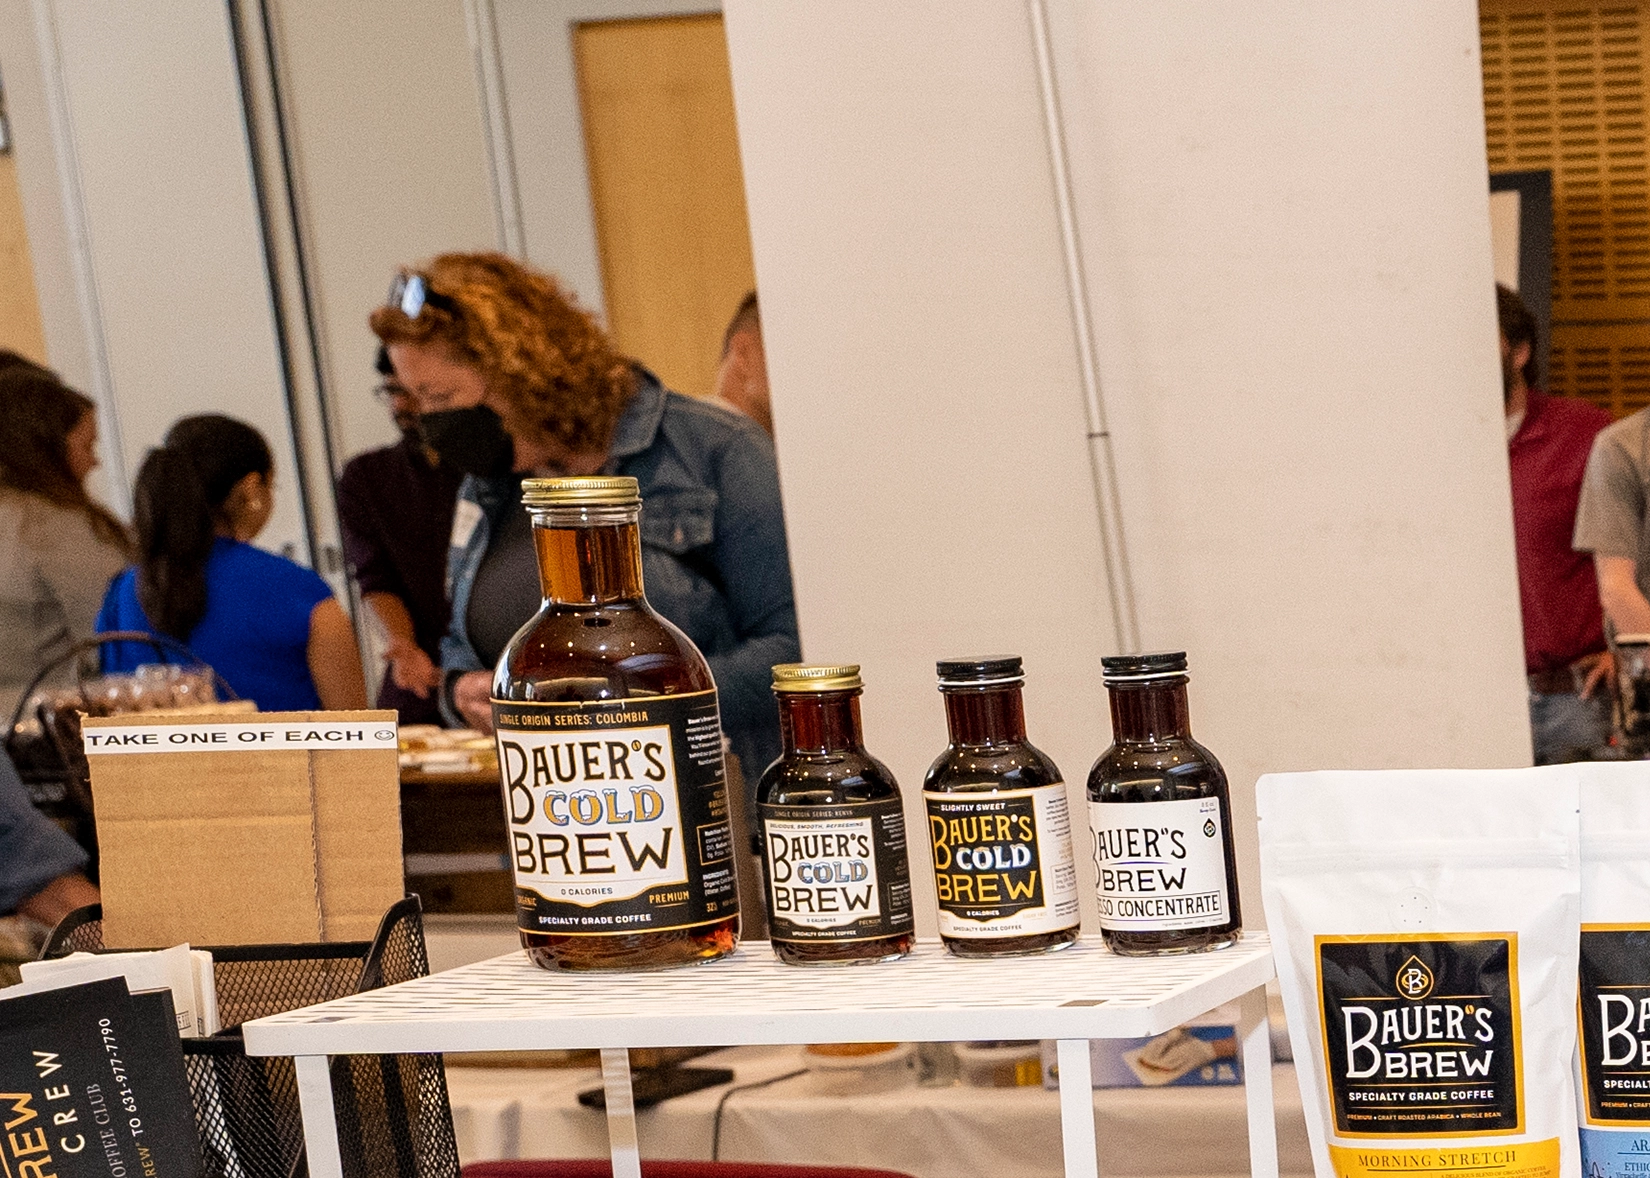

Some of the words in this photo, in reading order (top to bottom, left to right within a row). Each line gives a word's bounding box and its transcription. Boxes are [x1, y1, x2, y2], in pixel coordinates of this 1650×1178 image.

[500, 714, 520, 725] SINGLE
[522, 715, 551, 726] ORIGIN
[555, 714, 593, 726] SERIES:
[596, 711, 648, 724] COLOMBIA
[87, 733, 159, 747] TAKE
[168, 732, 228, 744] ONE
[238, 731, 275, 743] OF
[285, 730, 364, 742] EACH
[501, 740, 666, 825] BAUER'S
[543, 785, 665, 826] COLD
[940, 804, 974, 812] SLIGHTLY
[975, 802, 1006, 810] SWEET
[512, 827, 674, 875] BREW
[929, 814, 1033, 869] BAUER'S
[769, 833, 870, 883] BAUER'S
[956, 843, 1032, 870] COLD
[797, 859, 868, 884] COLD
[1102, 867, 1187, 892] BREW
[569, 888, 613, 896] CALORIES
[649, 890, 690, 903] PREMIUM
[774, 885, 873, 912] BREW
[937, 871, 1037, 902] BREW
[1117, 894, 1220, 917] CONCENTRATE
[539, 915, 579, 925] SPECIALTY
[582, 916, 613, 925] GRADE
[616, 914, 652, 923] COFFEE
[1341, 1004, 1494, 1079] BAUER'S
[98, 1018, 138, 1112] 631-977-7790
[1384, 1050, 1494, 1078] BREW
[33, 1051, 86, 1153] CREW
[86, 1083, 110, 1125] CLUB
[1349, 1092, 1405, 1101] SPECIALTY
[1409, 1091, 1447, 1101] GRADE
[1450, 1090, 1494, 1099] COFFEE
[129, 1118, 143, 1137] TO
[1358, 1155, 1431, 1167] MORNING
[1438, 1150, 1516, 1167] STRETCH
